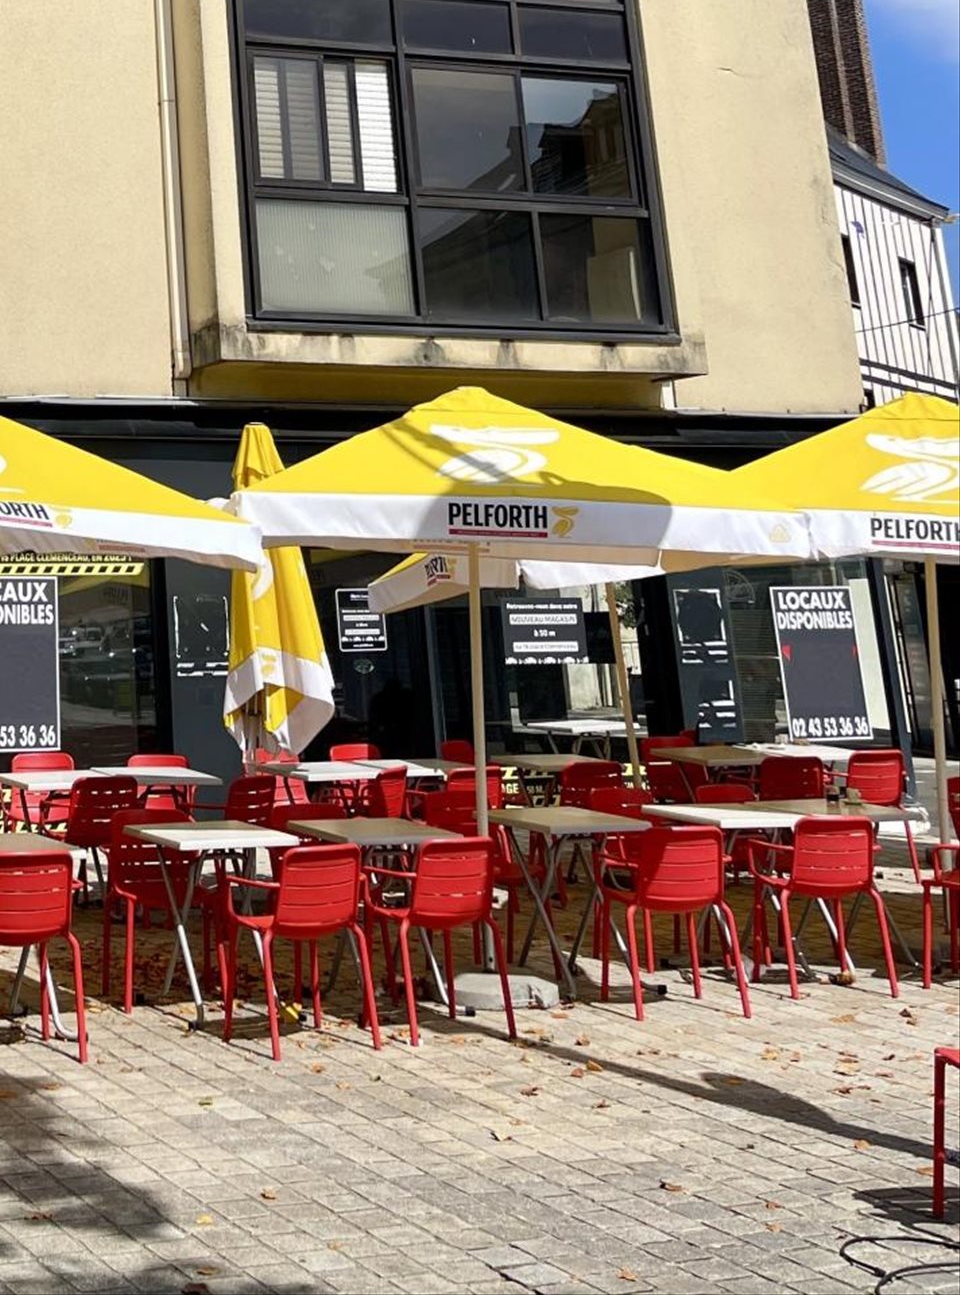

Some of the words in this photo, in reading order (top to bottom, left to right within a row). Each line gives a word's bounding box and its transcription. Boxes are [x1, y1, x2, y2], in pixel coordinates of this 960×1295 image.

[448, 502, 548, 529] PELFORTH
[778, 592, 846, 609] LOCAUX
[777, 612, 853, 629] DISPONIBLES
[0, 725, 16, 747] 53
[19, 725, 36, 747] 36
[39, 724, 56, 746] 36
[792, 718, 807, 737] 02
[808, 718, 823, 736] 43
[824, 717, 838, 736] 53
[839, 716, 854, 735] 36
[854, 716, 869, 735] 36
